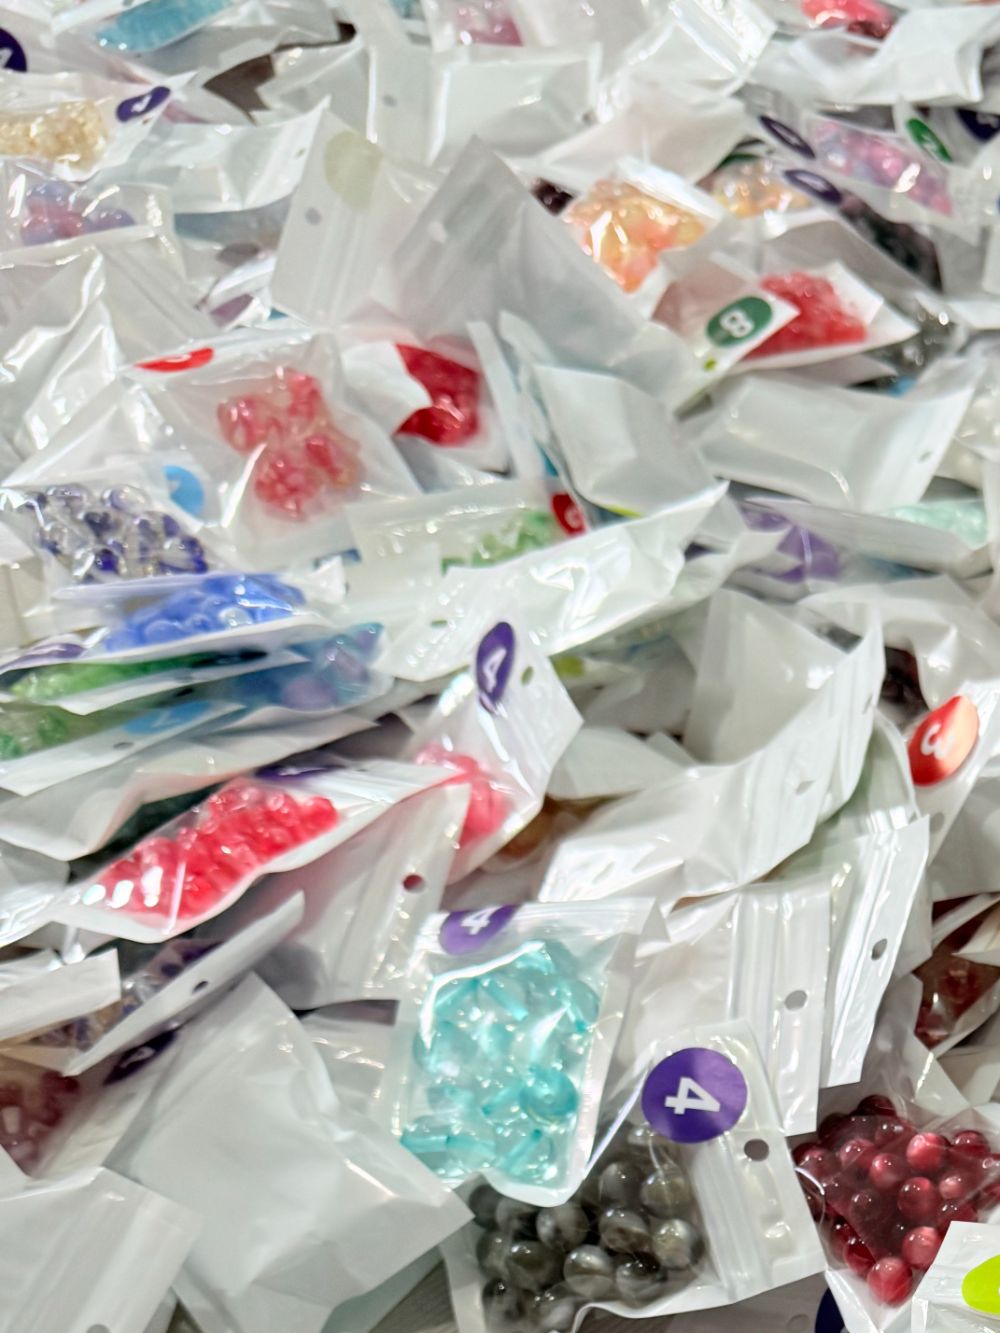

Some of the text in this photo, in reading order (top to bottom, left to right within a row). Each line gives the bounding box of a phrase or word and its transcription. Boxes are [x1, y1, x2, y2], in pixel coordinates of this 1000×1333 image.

[720, 310, 755, 338] 8
[460, 903, 503, 936] 4
[665, 1077, 721, 1115] 4
